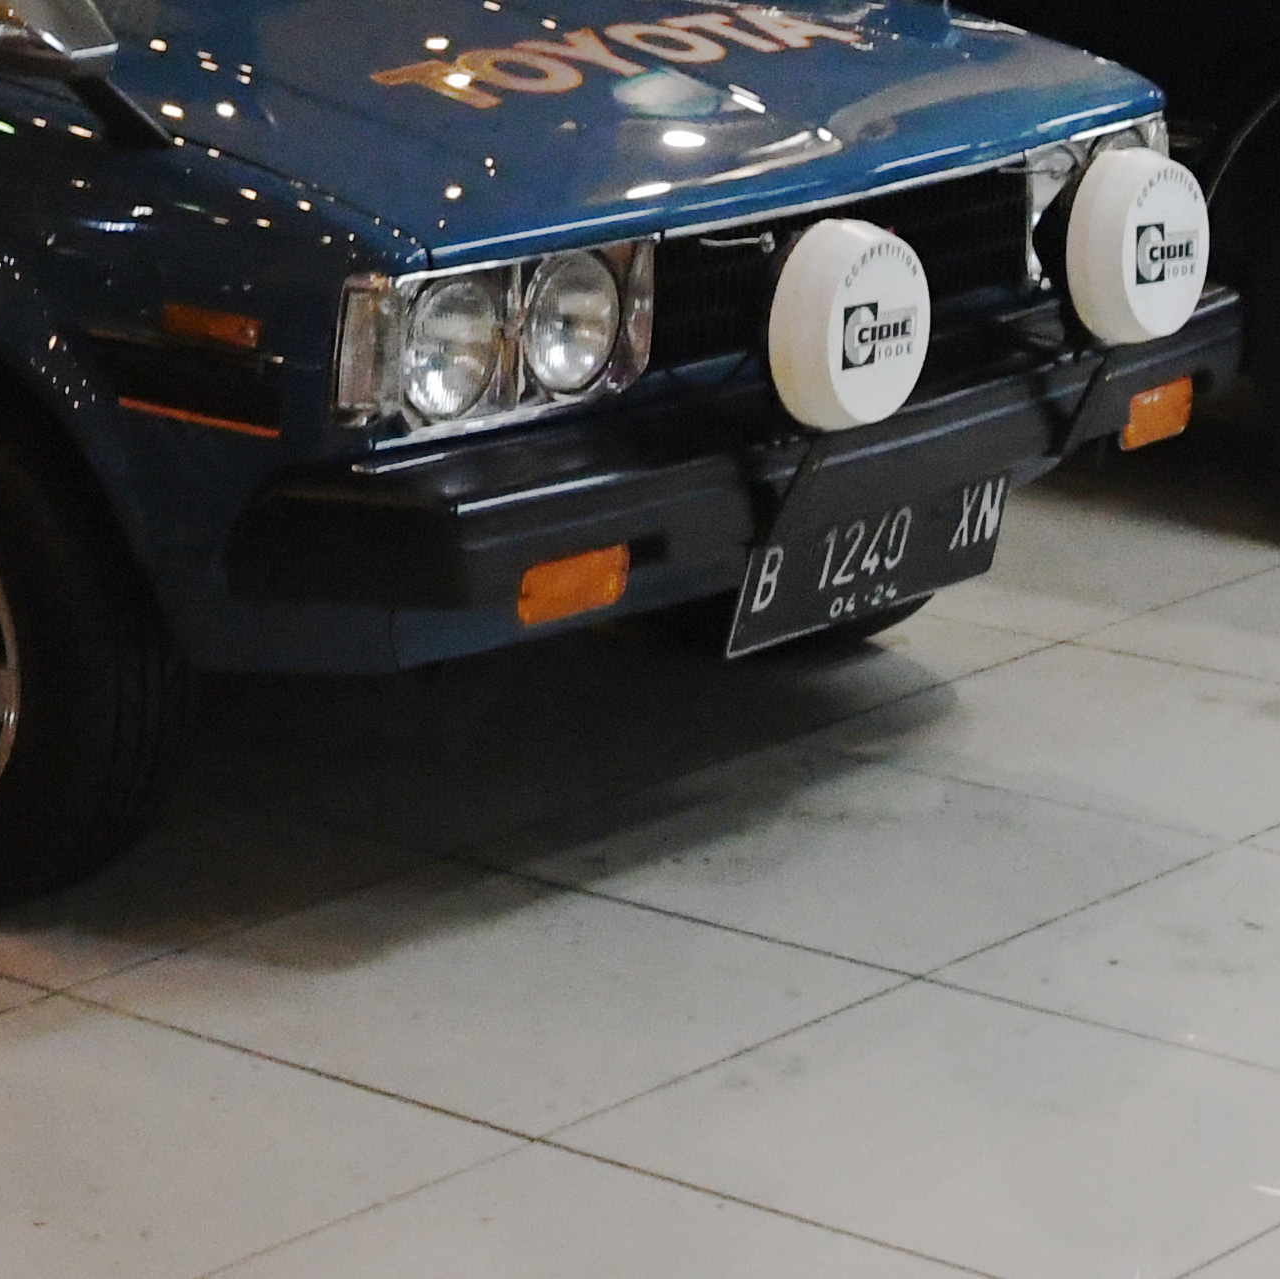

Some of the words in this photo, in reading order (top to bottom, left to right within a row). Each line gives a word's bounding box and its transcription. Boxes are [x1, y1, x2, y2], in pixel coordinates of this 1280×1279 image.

[370, 4, 861, 109] TOYOTA
[844, 242, 918, 288] COMPETITION
[877, 340, 914, 360] IODE
[751, 545, 785, 613] B
[818, 506, 913, 591] 1240
[949, 476, 1006, 552] XN
